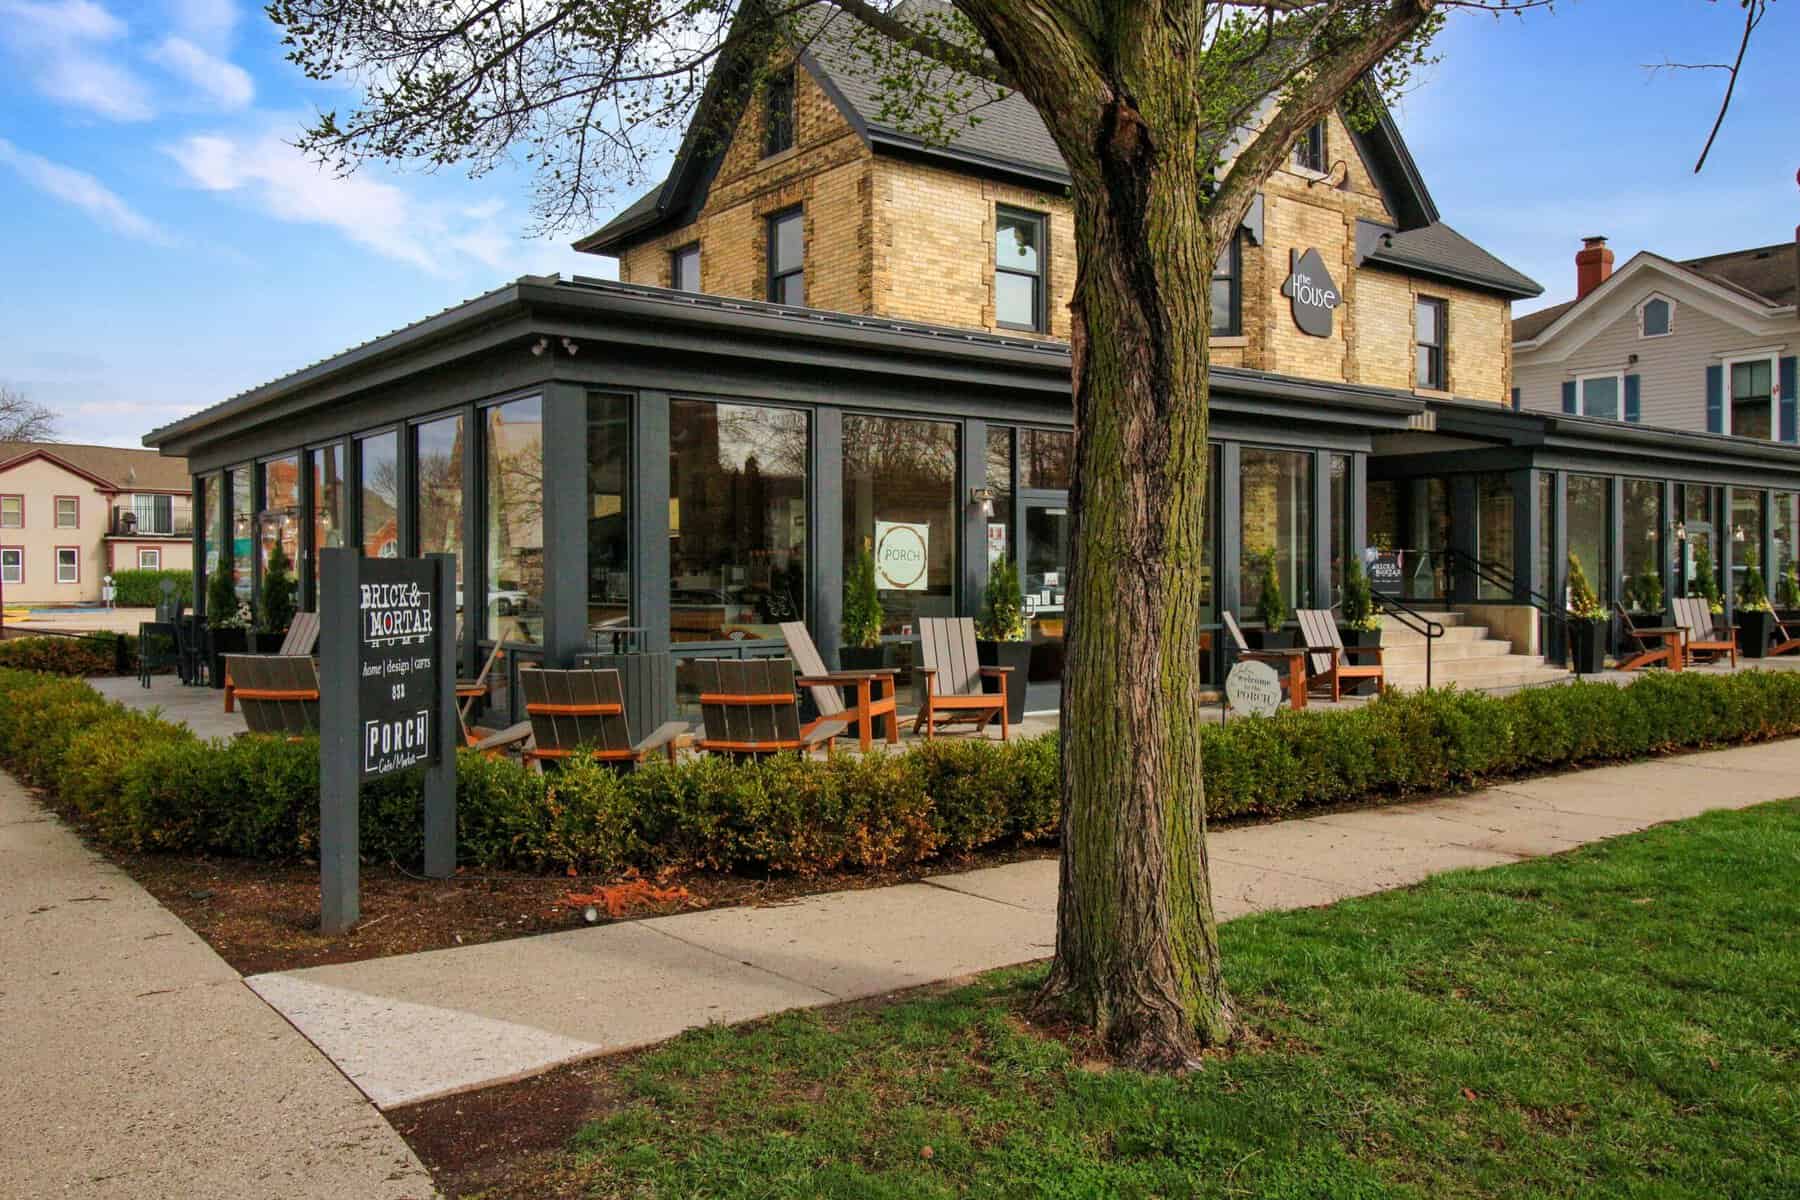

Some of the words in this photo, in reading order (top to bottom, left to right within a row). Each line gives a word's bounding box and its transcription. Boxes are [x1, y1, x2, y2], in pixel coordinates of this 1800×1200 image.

[885, 549, 921, 561] PORCH
[370, 609, 433, 637] MORTAR
[362, 661, 382, 677] home
[386, 658, 410, 675] design
[414, 658, 431, 669] GIFTS
[370, 716, 425, 757] PORCH
